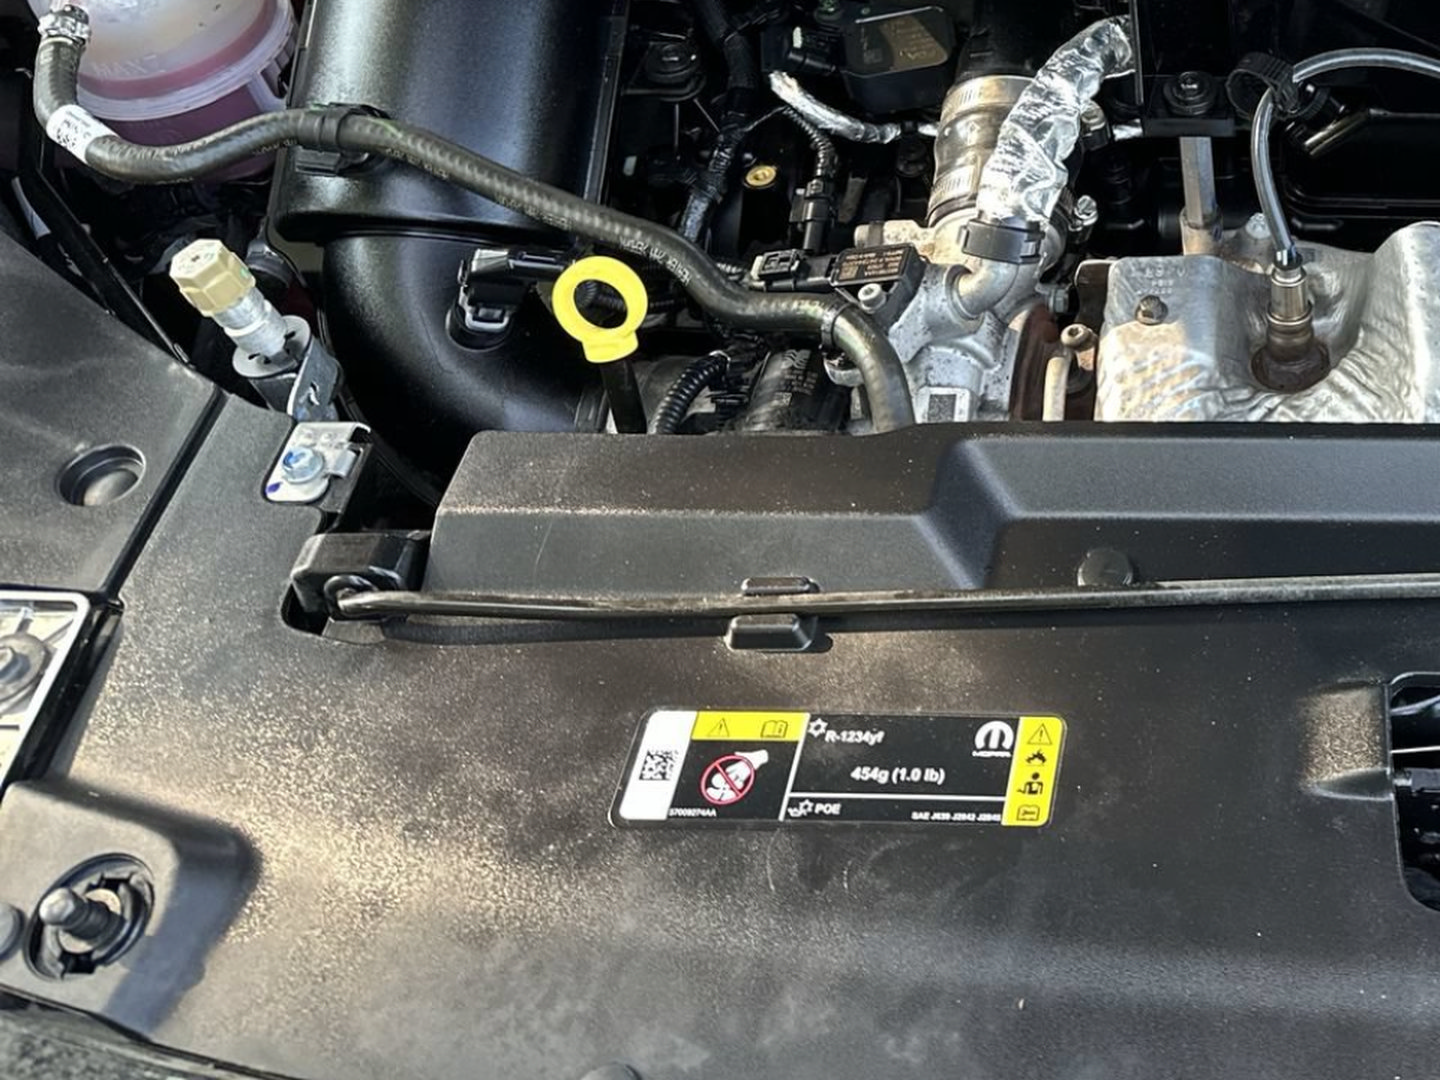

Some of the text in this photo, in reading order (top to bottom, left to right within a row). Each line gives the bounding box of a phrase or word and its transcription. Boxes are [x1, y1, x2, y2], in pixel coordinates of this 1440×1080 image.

[824, 729, 885, 747] R-1234yf
[850, 765, 946, 786] 454g (1.0 lb)
[813, 802, 842, 816] POE
[910, 810, 930, 820] SAE
